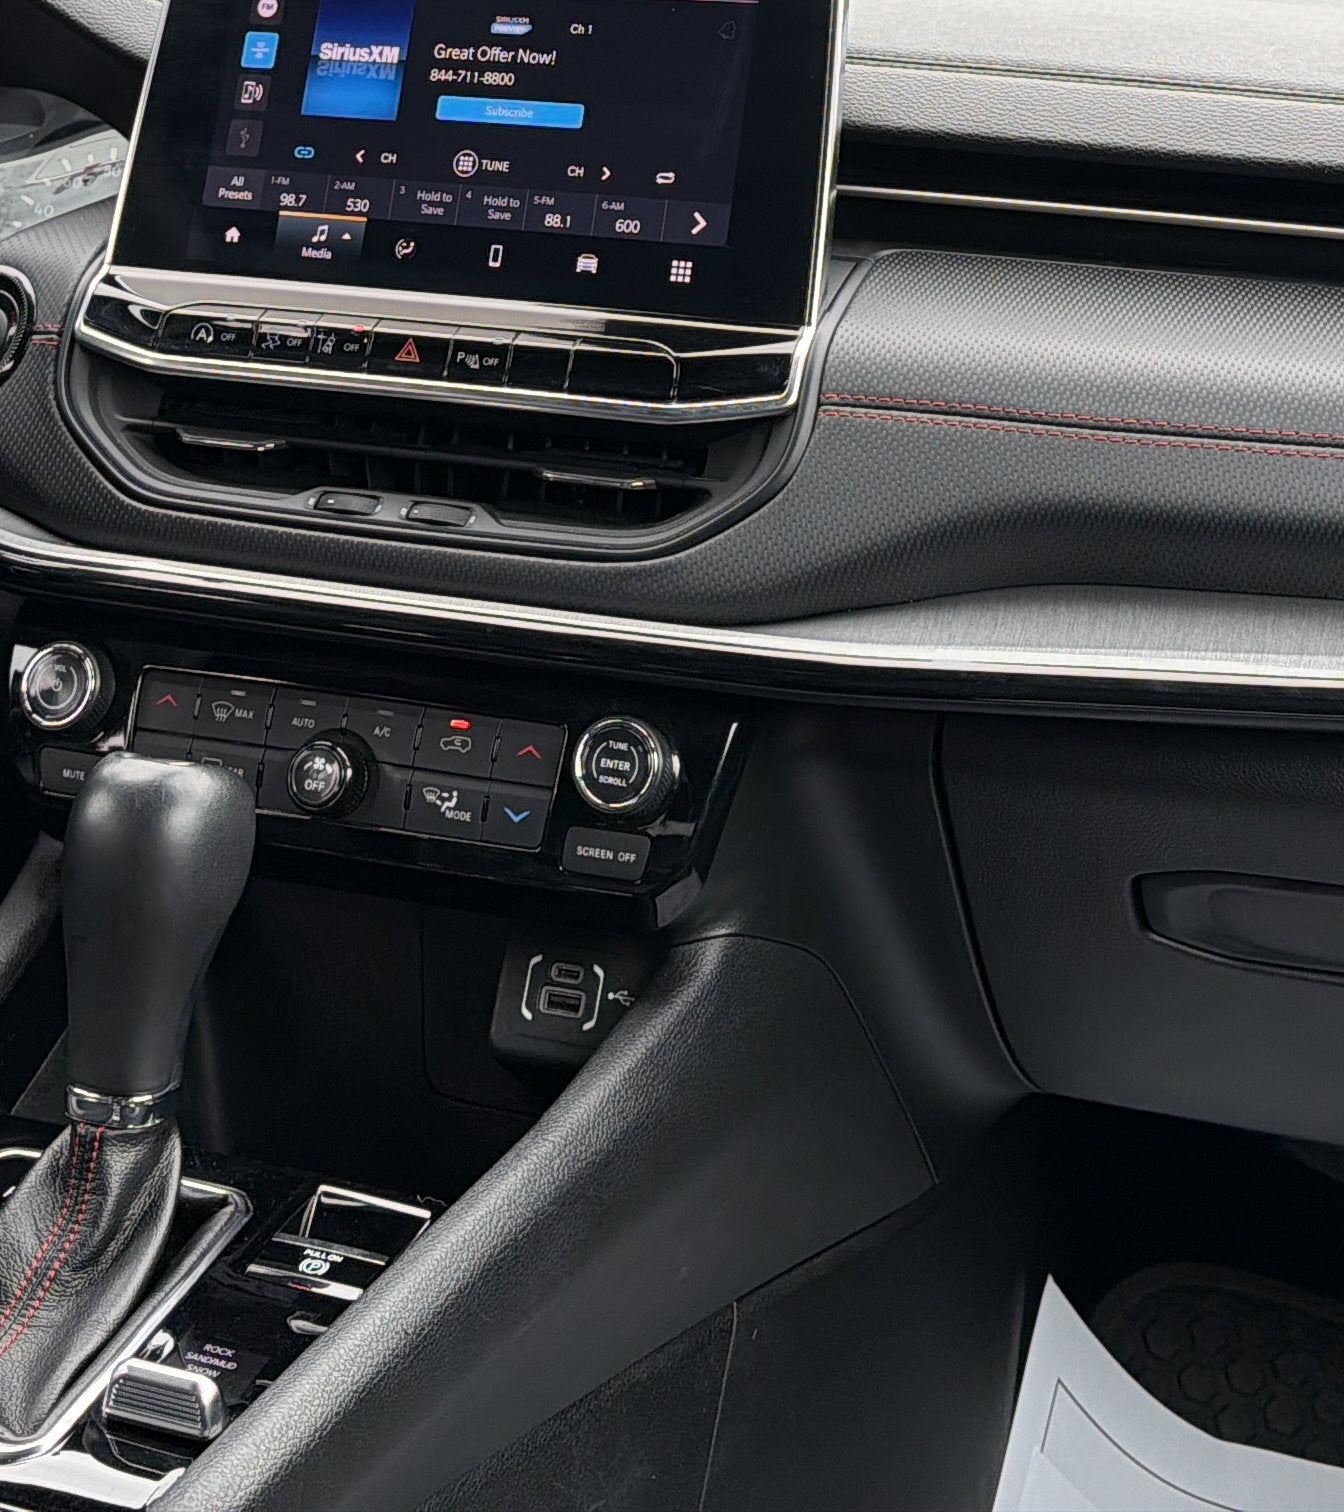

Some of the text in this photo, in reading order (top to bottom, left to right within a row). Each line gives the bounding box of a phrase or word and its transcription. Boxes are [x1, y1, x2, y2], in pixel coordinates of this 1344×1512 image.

[569, 23, 586, 35] Ch
[319, 42, 401, 64] SiriusXM
[433, 43, 557, 66] Great Offer Now!
[429, 69, 515, 87] 844-711-8800
[484, 105, 534, 120] Subscribe
[380, 152, 397, 165] CH
[480, 159, 510, 173] TUNE
[567, 165, 584, 178] CH
[230, 175, 245, 188] All
[333, 179, 356, 192] 2-AM
[218, 187, 253, 202] Presets
[279, 193, 307, 208] 98.7
[416, 189, 453, 204] Hold to
[465, 190, 473, 201] 4
[483, 194, 521, 209] Hold to
[32, 204, 55, 217] 40
[345, 198, 370, 214] 530
[420, 203, 445, 217] Save
[601, 201, 625, 212] 6-AM
[487, 208, 513, 222] Save
[544, 213, 571, 229] 88.1
[614, 218, 641, 234] 600
[301, 246, 333, 260] Media
[220, 332, 237, 343] OFF
[286, 337, 303, 348] OFF
[343, 342, 360, 352] OFF
[482, 356, 500, 367] OFF
[234, 708, 254, 721] MAX
[292, 715, 315, 729] AUTO
[373, 725, 391, 739] A/C
[608, 740, 629, 752] TUNE
[600, 758, 631, 773] ENTER
[62, 768, 86, 781] MUTE
[598, 774, 628, 788] SCROLL
[304, 779, 326, 792] OFF
[445, 809, 472, 823] MODE
[576, 845, 637, 864] SCREEN OFF
[203, 1343, 237, 1358] ROCK
[185, 1351, 238, 1371] SAND/MUD
[185, 1363, 221, 1378] SNOW
